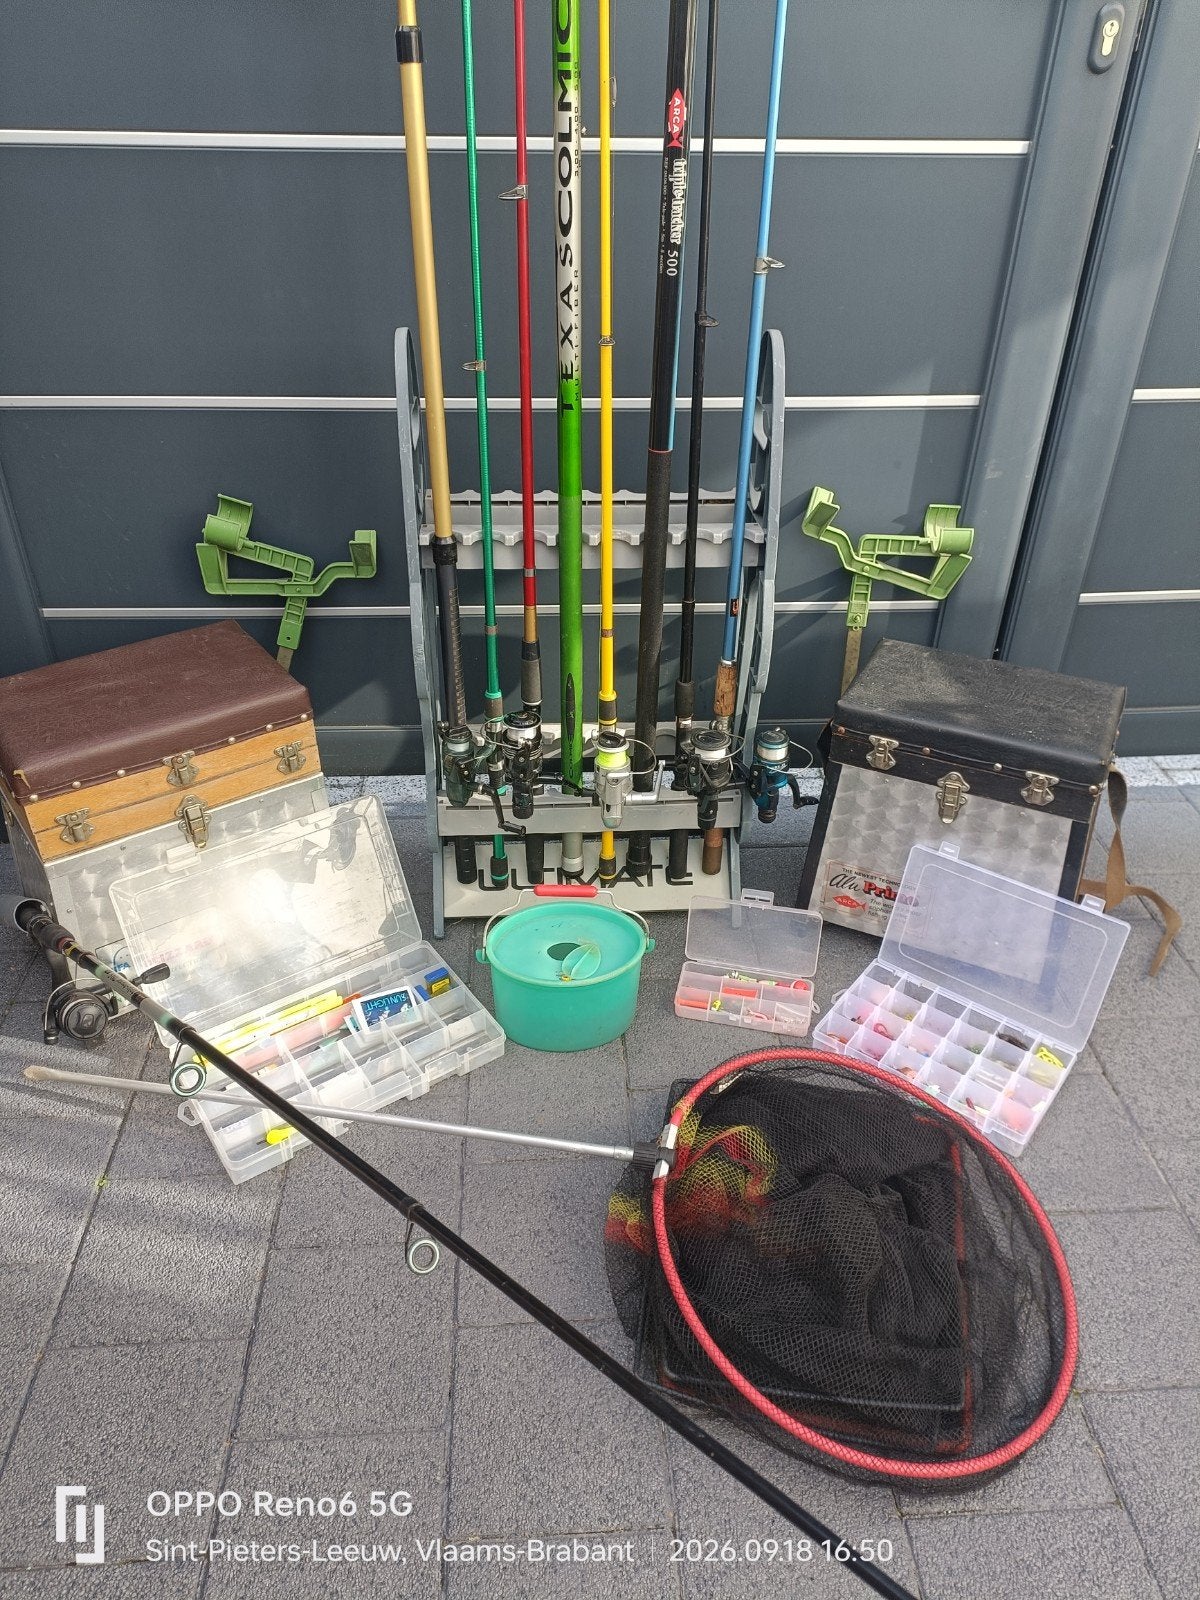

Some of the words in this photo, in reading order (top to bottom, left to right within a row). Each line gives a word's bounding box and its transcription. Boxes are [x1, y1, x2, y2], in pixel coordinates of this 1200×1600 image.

[556, 0, 573, 238] COLMIC
[672, 96, 681, 134] ARCA
[666, 249, 679, 277] 500
[560, 243, 574, 418] TEXAS
[829, 873, 860, 891] Alu
[842, 867, 853, 875] THE
[854, 871, 877, 880] NEWEST
